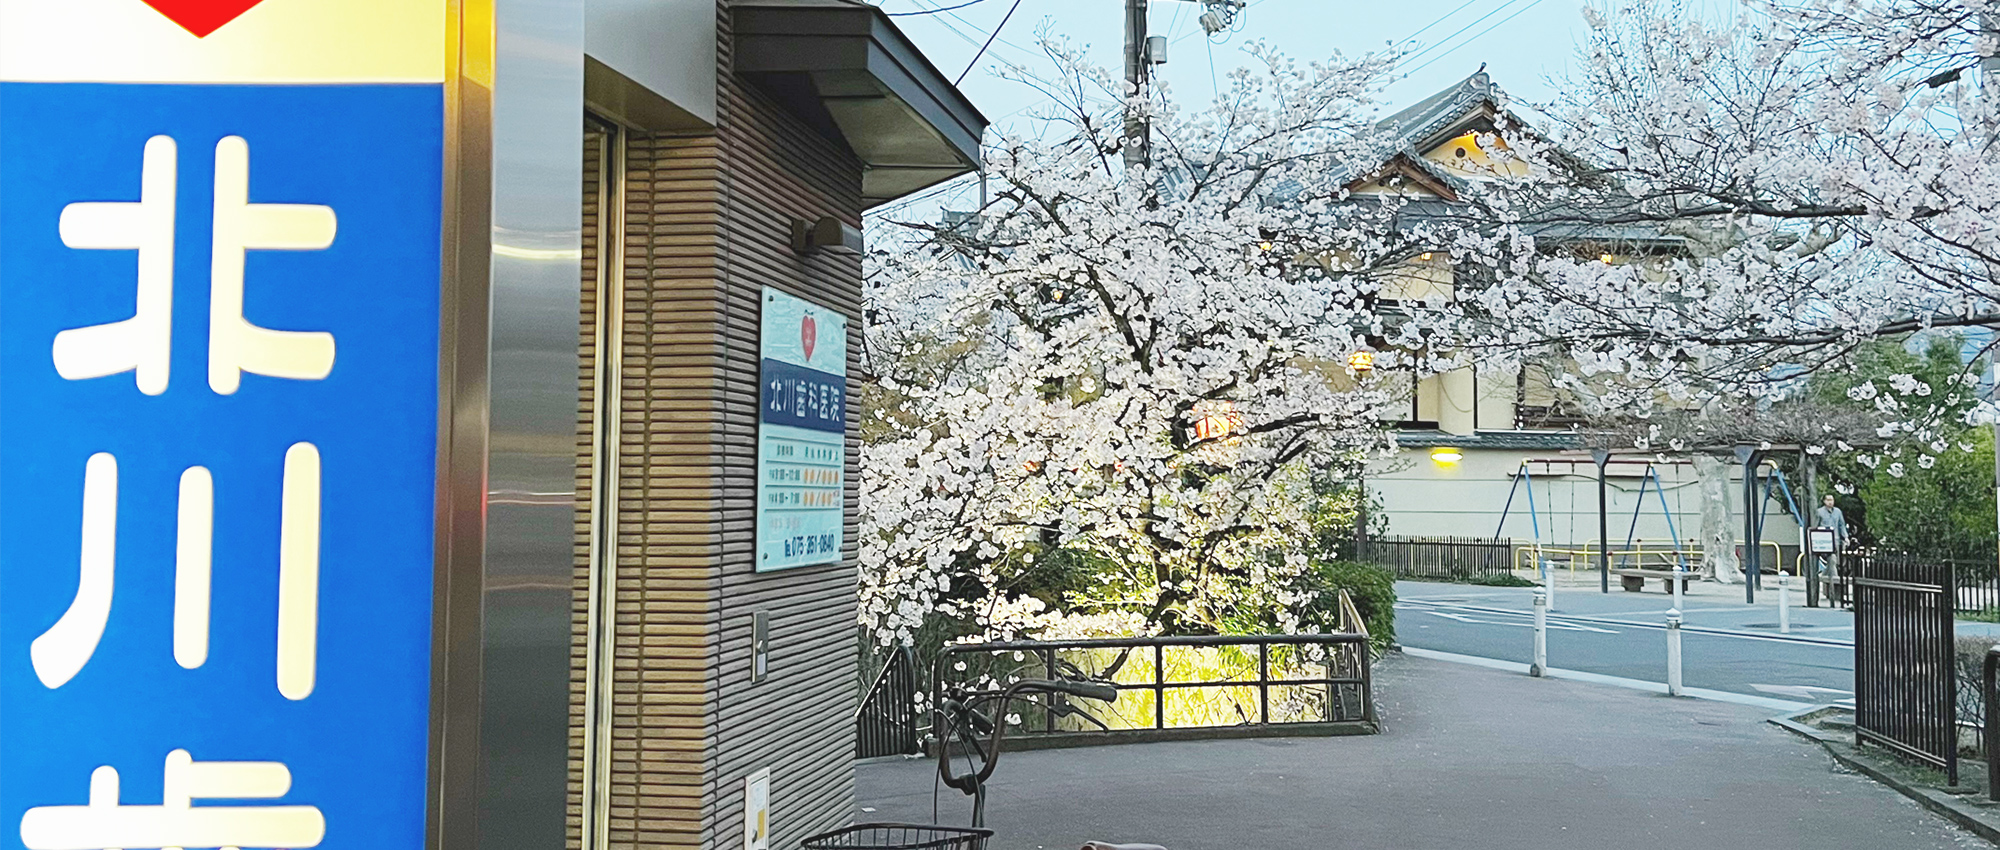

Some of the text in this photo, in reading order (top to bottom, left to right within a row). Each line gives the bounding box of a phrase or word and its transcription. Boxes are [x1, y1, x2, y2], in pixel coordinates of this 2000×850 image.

[770, 375, 840, 422] 北川歯科医院
